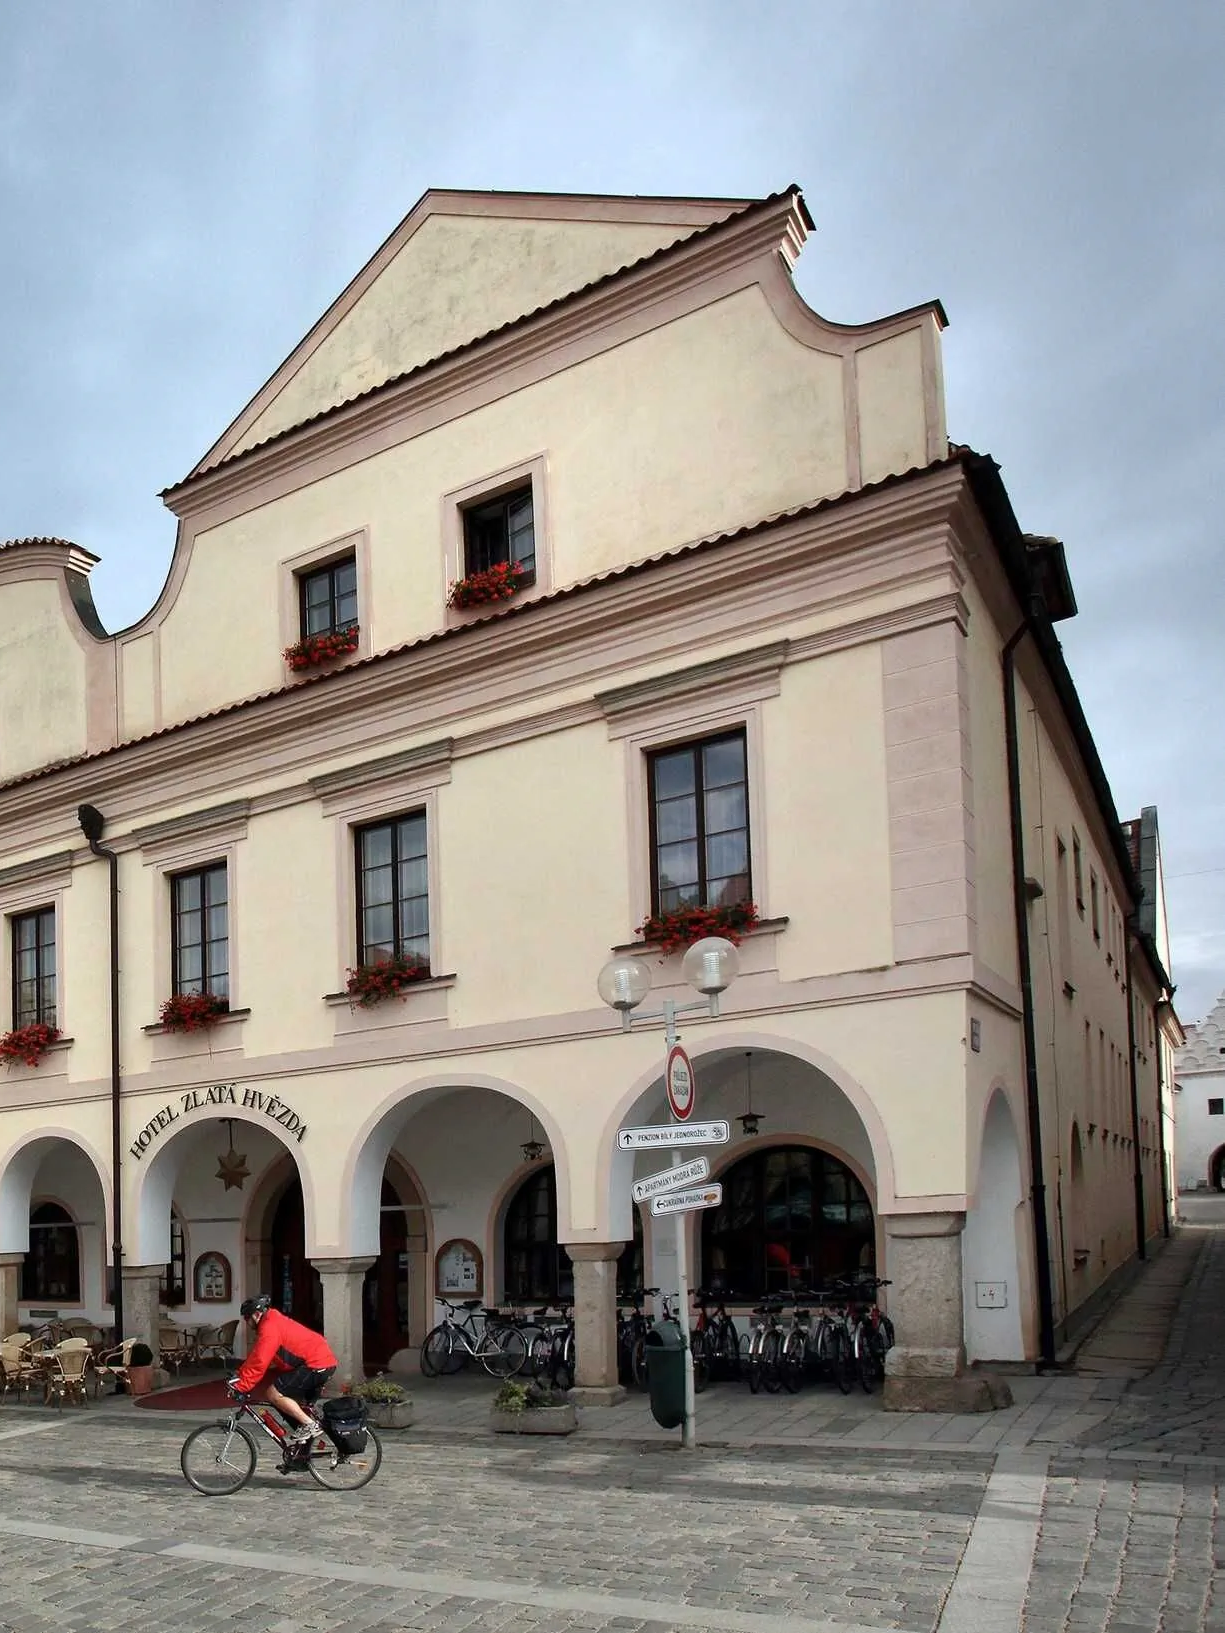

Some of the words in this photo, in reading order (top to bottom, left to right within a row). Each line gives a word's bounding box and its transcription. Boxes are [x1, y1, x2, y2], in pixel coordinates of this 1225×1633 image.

[129, 1104, 179, 1161] HOTEL
[180, 1082, 237, 1113] ZLATÁ
[241, 1087, 309, 1144] HVĚZDA
[638, 1133, 659, 1142] PENZION
